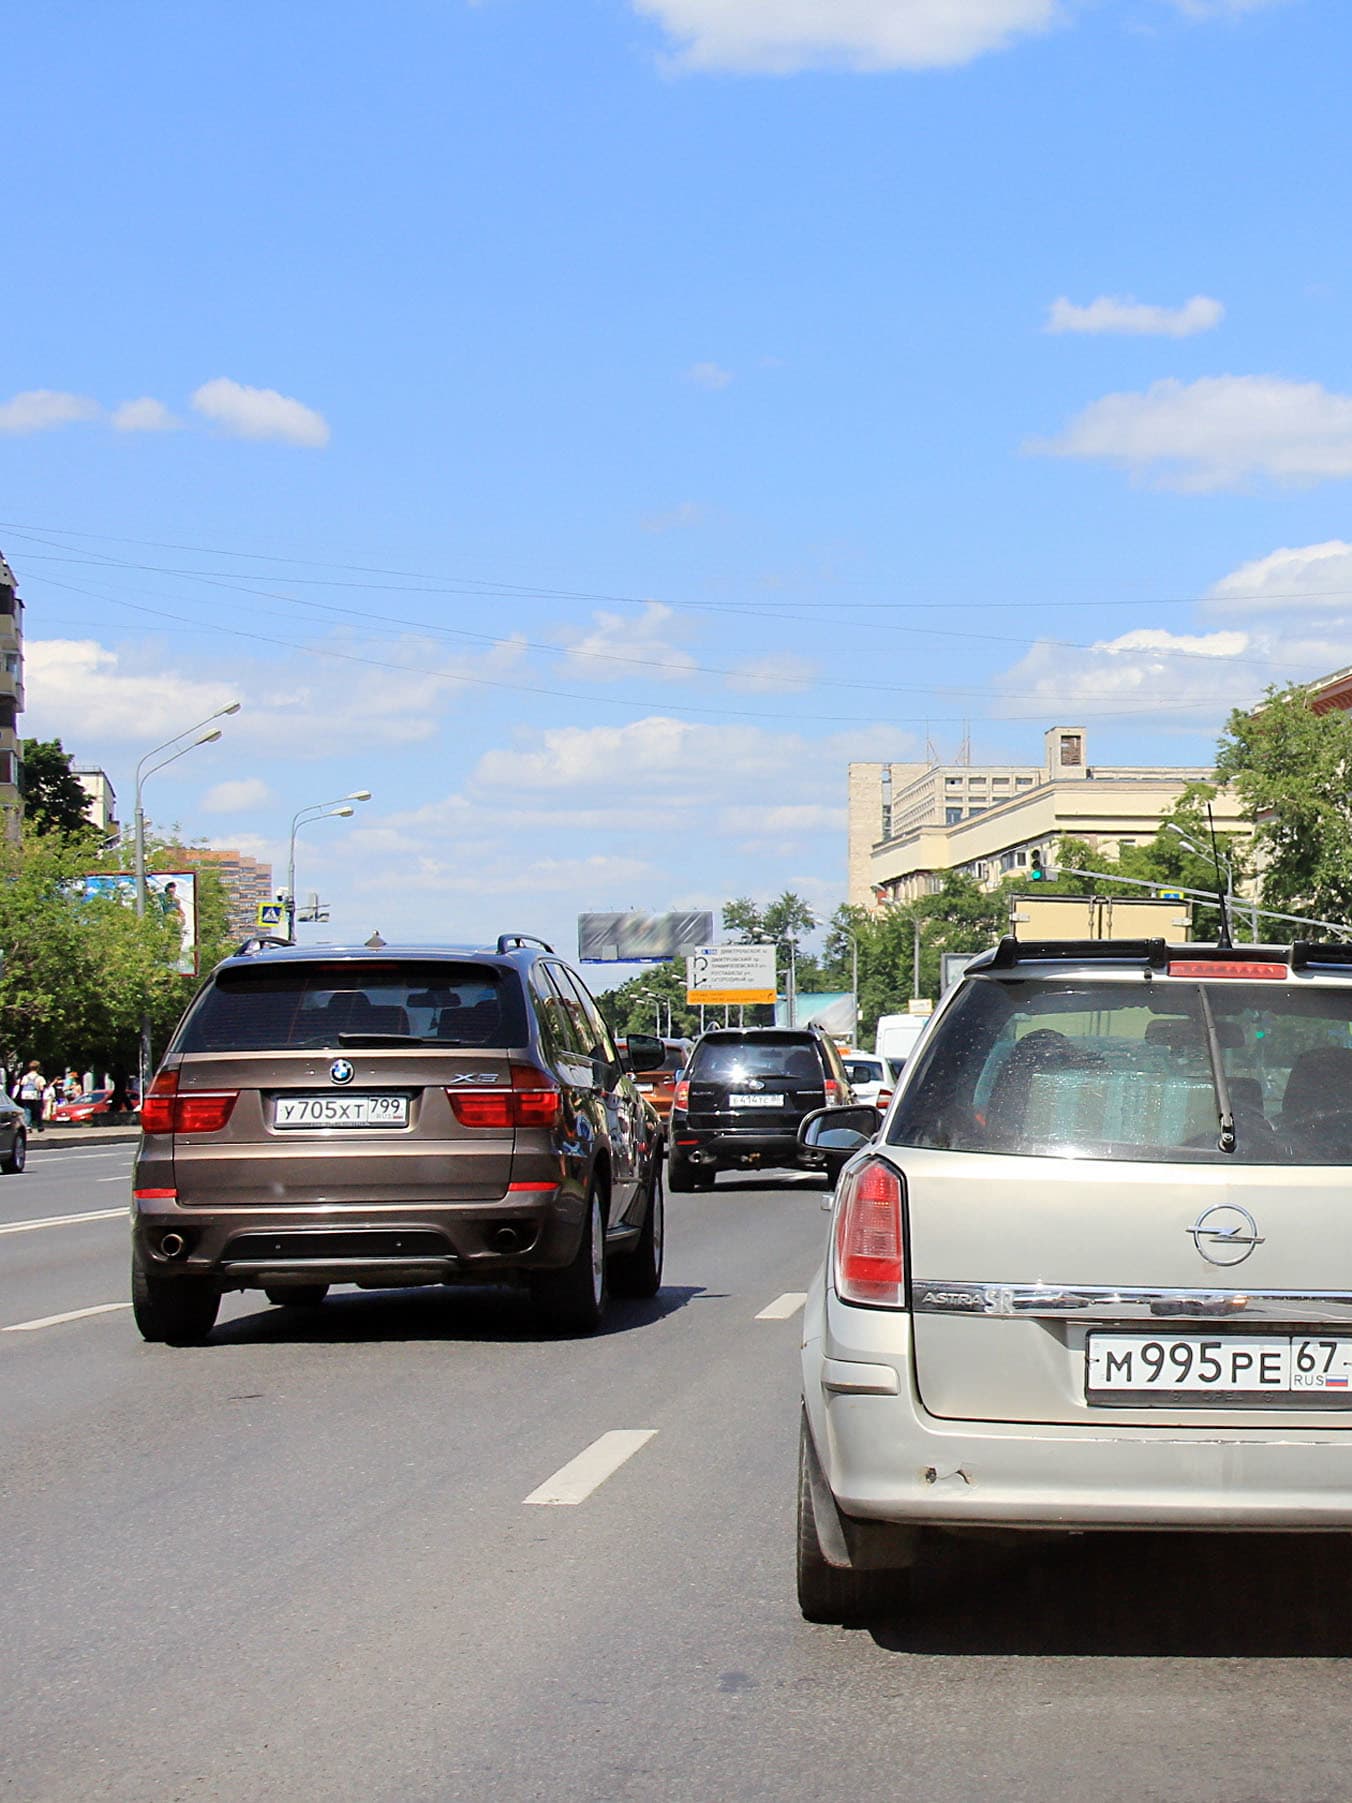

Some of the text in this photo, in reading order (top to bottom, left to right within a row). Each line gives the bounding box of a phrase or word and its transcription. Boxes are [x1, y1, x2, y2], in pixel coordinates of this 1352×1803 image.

[450, 1073, 499, 1084] X5
[285, 1099, 400, 1119] У705ХТ 799
[922, 1291, 984, 1305] ASTRA
[1105, 1341, 1337, 1383] М995РЕ 67
[1294, 1375, 1324, 1386] RUS
